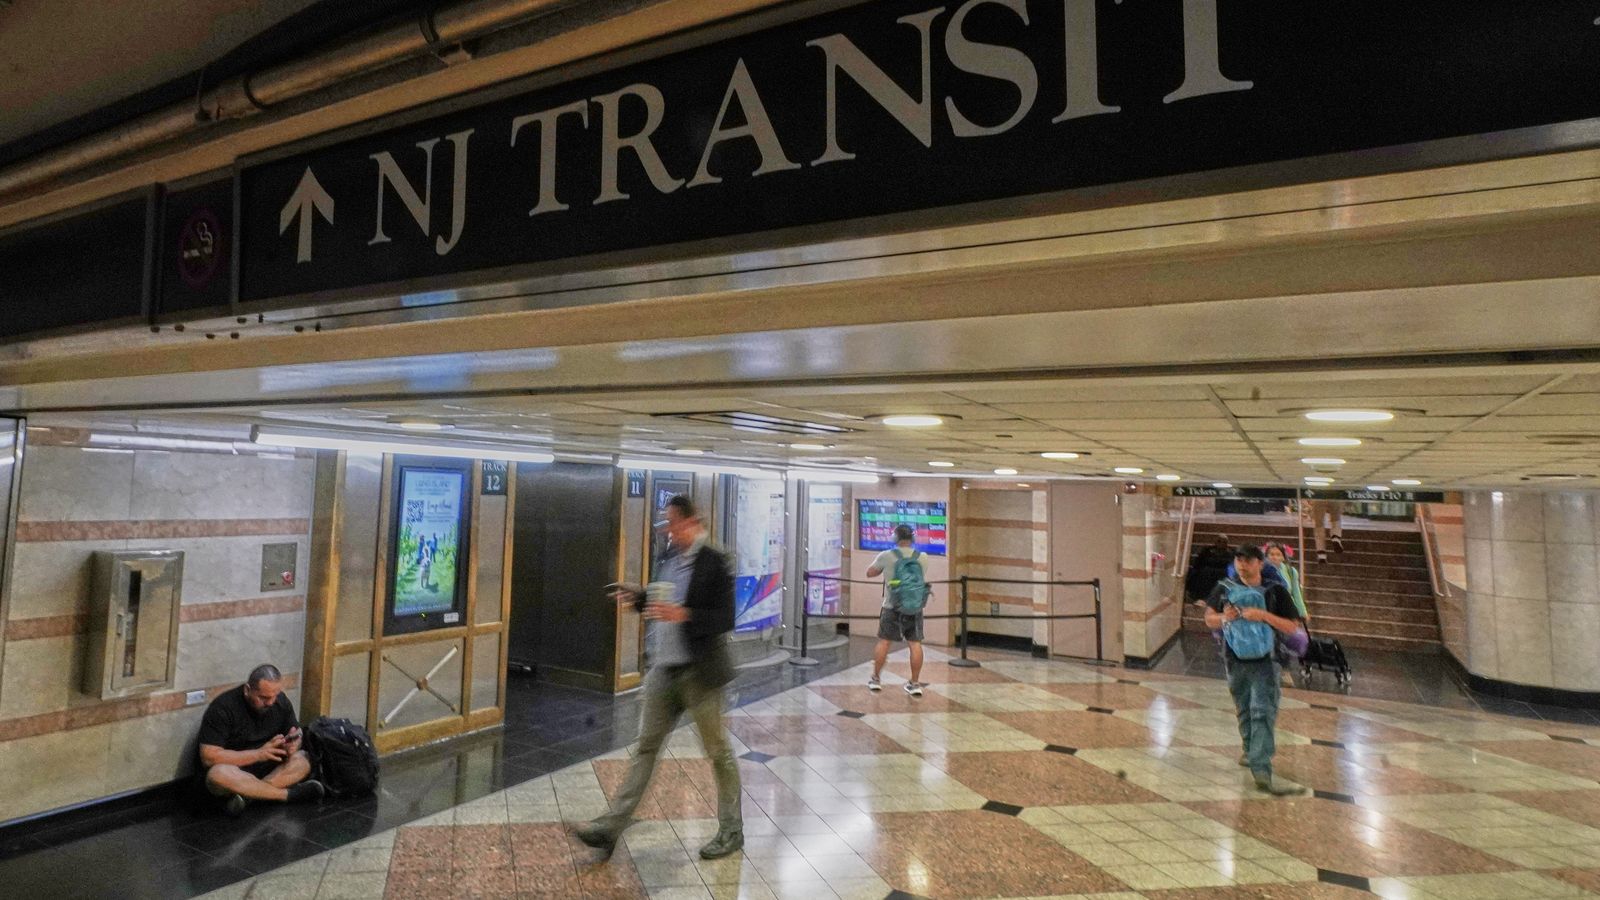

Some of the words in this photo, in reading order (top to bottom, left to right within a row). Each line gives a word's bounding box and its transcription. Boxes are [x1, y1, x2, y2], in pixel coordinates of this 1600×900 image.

[367, 128, 475, 256] NJ
[510, 0, 1254, 219] TRANSIT
[483, 462, 507, 472] TRACK
[486, 475, 501, 491] 12
[631, 481, 640, 495] 11
[1188, 487, 1218, 497] Tickets
[1345, 490, 1378, 500] Tracks
